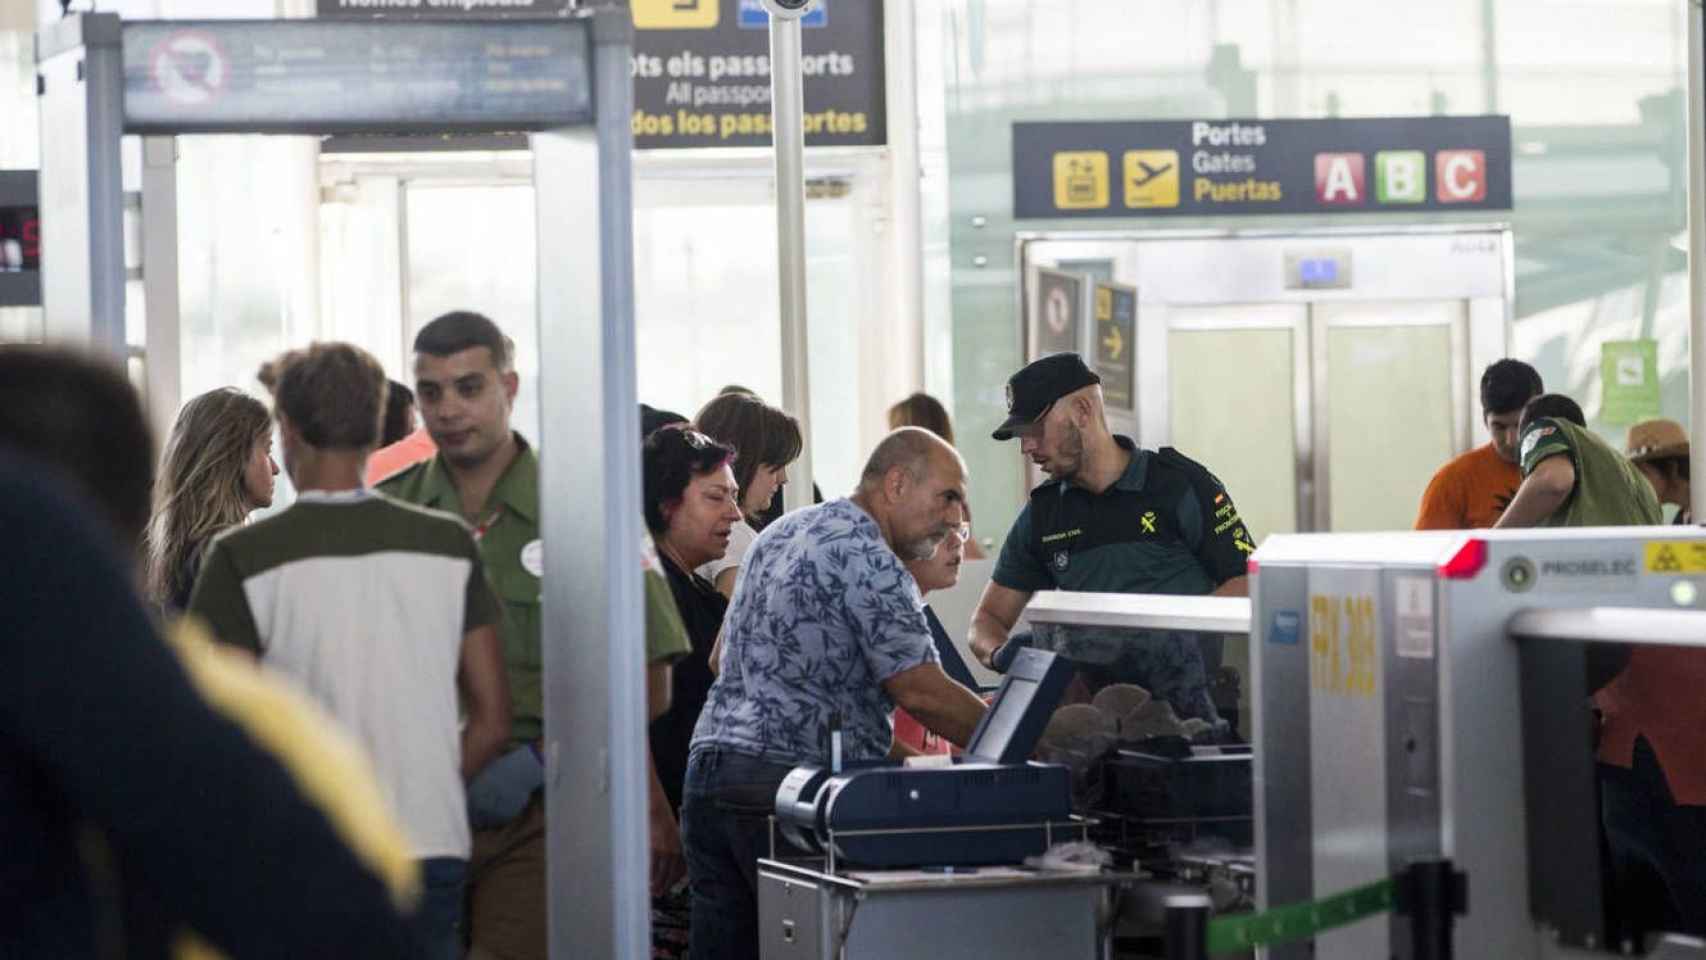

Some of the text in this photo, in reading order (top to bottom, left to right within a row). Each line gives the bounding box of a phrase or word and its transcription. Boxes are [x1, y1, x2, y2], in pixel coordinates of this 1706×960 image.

[667, 51, 704, 77] els
[709, 53, 854, 82] passorts
[666, 82, 773, 107] All passpor
[631, 110, 867, 139] dos los pasaortes
[1192, 121, 1266, 146] Portes
[1192, 150, 1256, 174] Gates
[1194, 177, 1282, 202] Puertas
[1324, 153, 1478, 201] A B C
